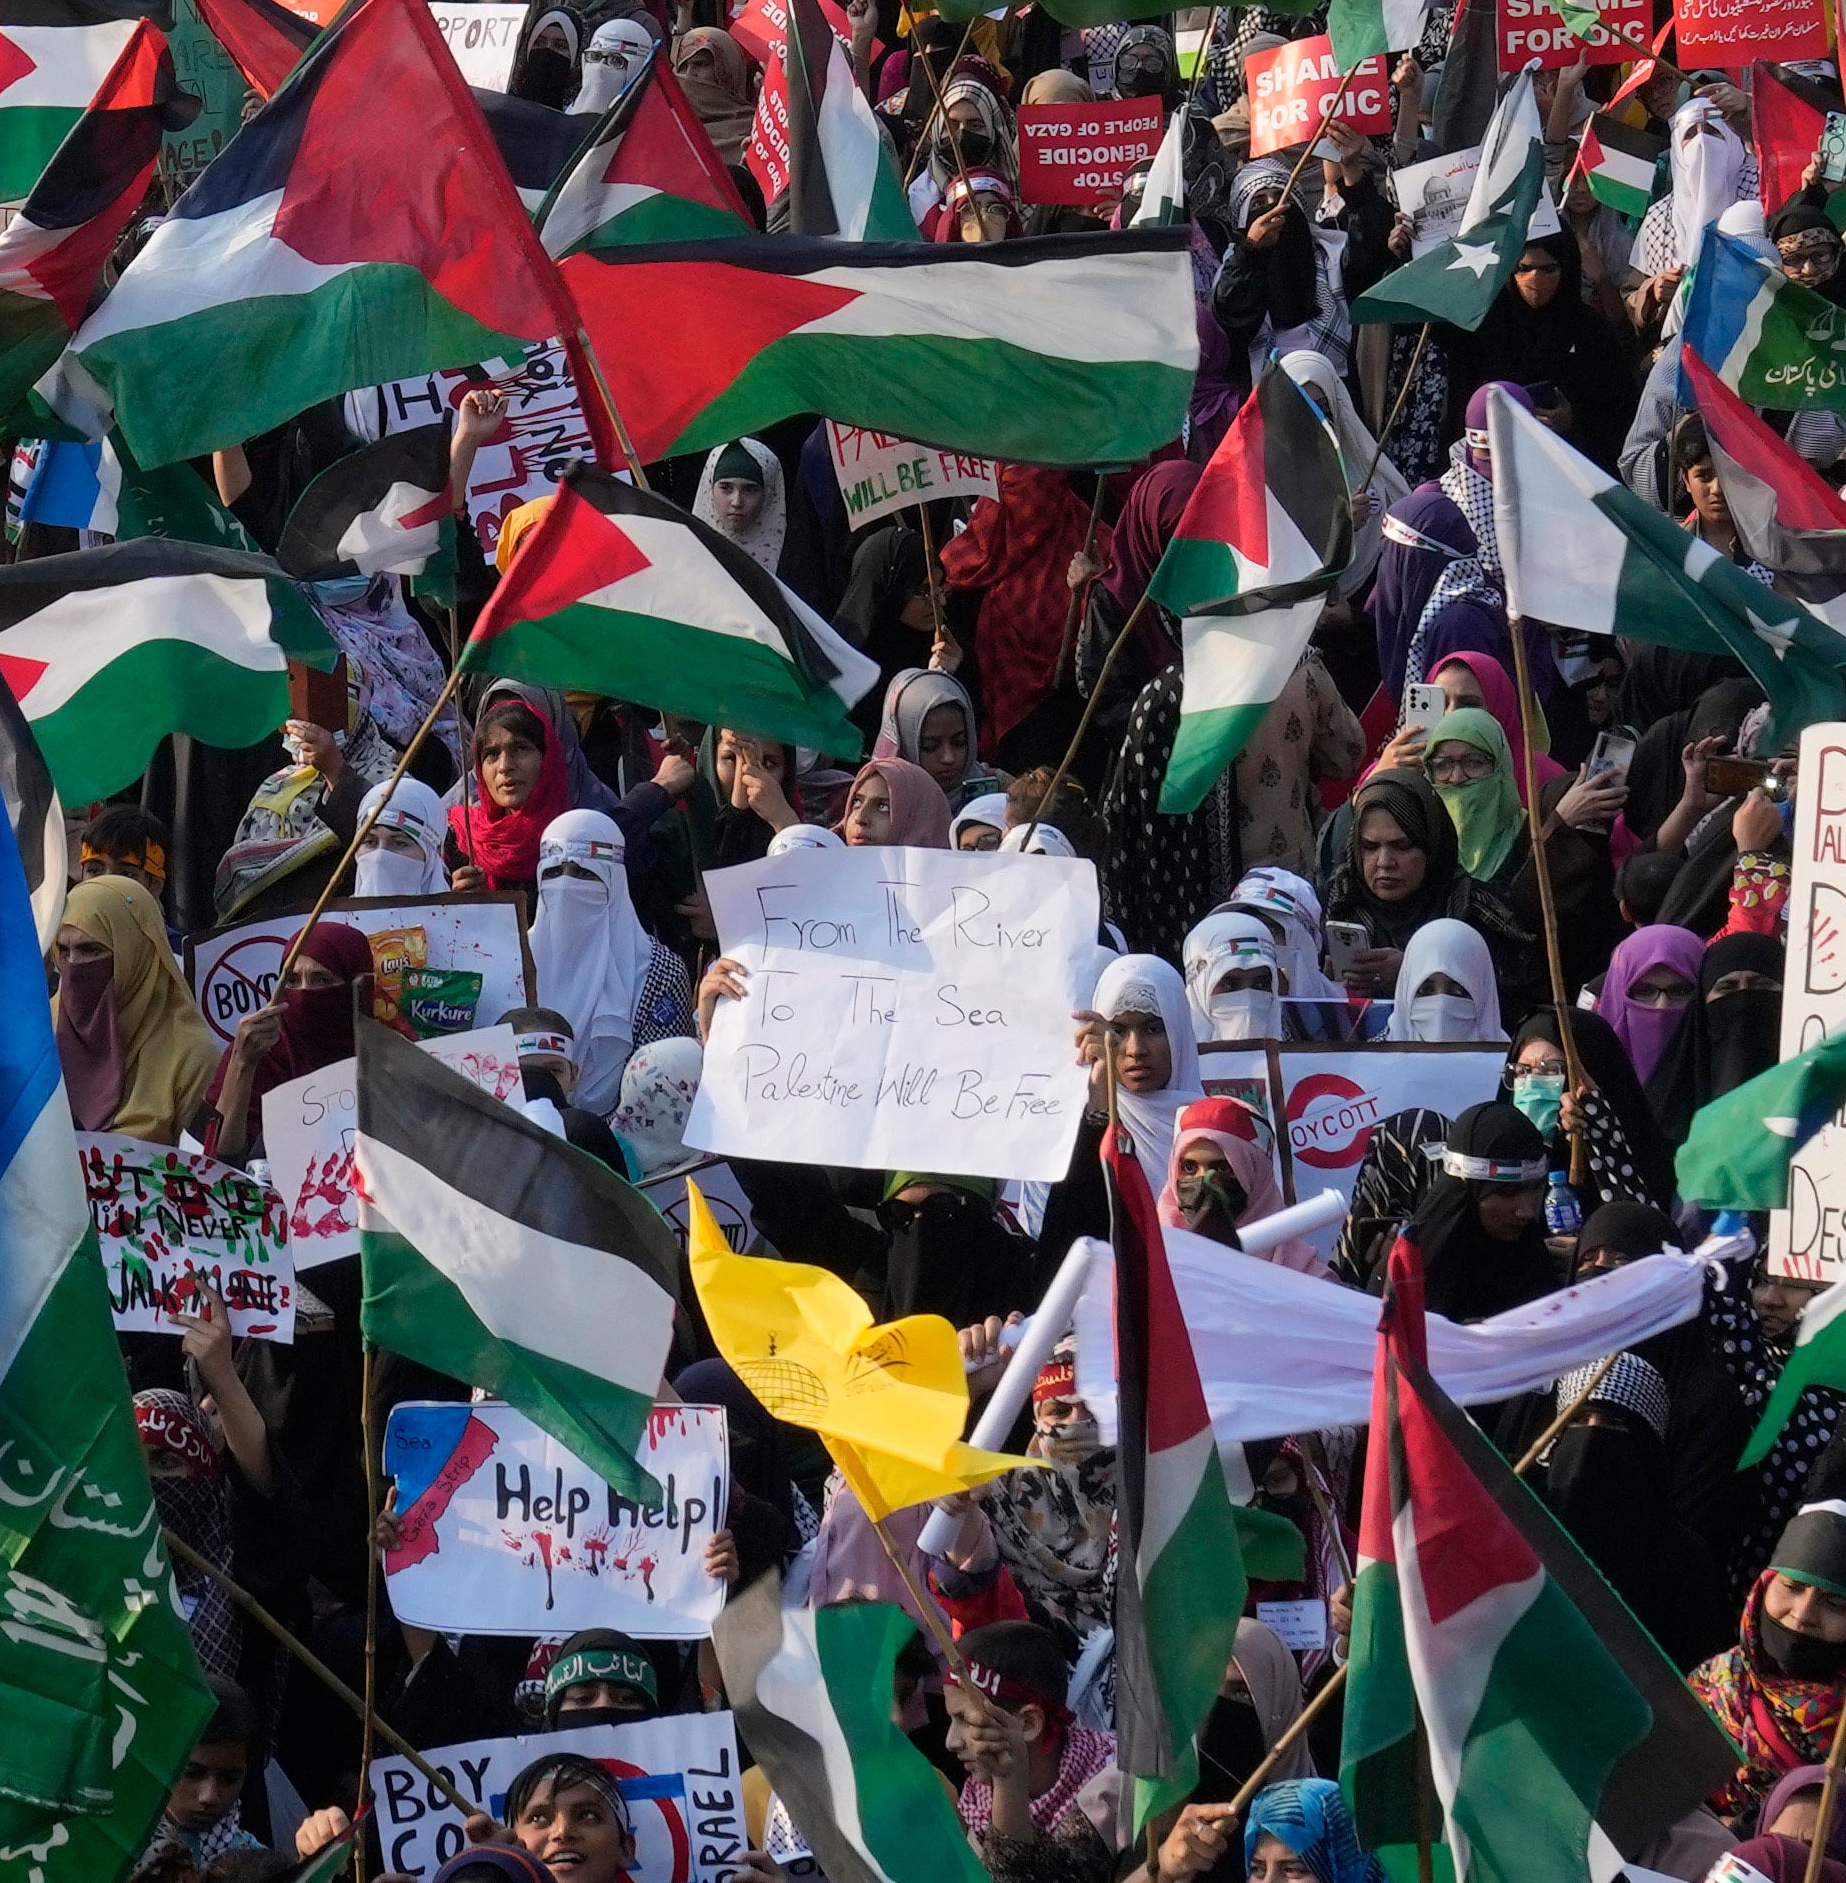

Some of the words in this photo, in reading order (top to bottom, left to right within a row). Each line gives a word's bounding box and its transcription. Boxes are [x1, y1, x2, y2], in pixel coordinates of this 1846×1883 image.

[1507, 27, 1576, 54] FOR
[1586, 19, 1645, 47] OIC
[1255, 49, 1379, 98] SHAME
[1024, 121, 1072, 138] GAZA
[1076, 120, 1099, 137] OF
[1105, 115, 1159, 138] PEOPLE
[1255, 100, 1309, 137] FOR
[1319, 88, 1383, 119] OIC
[1038, 141, 1149, 166] GENOCIDE
[1072, 167, 1125, 188] STOP
[1764, 356, 1816, 397] پاکستان
[842, 467, 897, 516] WILL
[897, 457, 935, 492] BE
[939, 453, 991, 485] FREE
[757, 884, 856, 957] From
[877, 881, 923, 947] The
[951, 887, 1044, 949] River
[410, 998, 472, 1023] Kurkure
[760, 970, 797, 1027] To
[840, 974, 899, 1025] The
[937, 984, 1008, 1027] Sea
[744, 1044, 863, 1108] Palestine
[874, 1064, 938, 1108] Will
[952, 1070, 998, 1119] Be
[1006, 1073, 1058, 1119] Free
[156, 1200, 250, 1240] NEVER
[394, 1428, 432, 1451] Sea
[495, 1459, 594, 1539] Help
[607, 1473, 721, 1555] Help!
[384, 1756, 492, 1825] BOY
